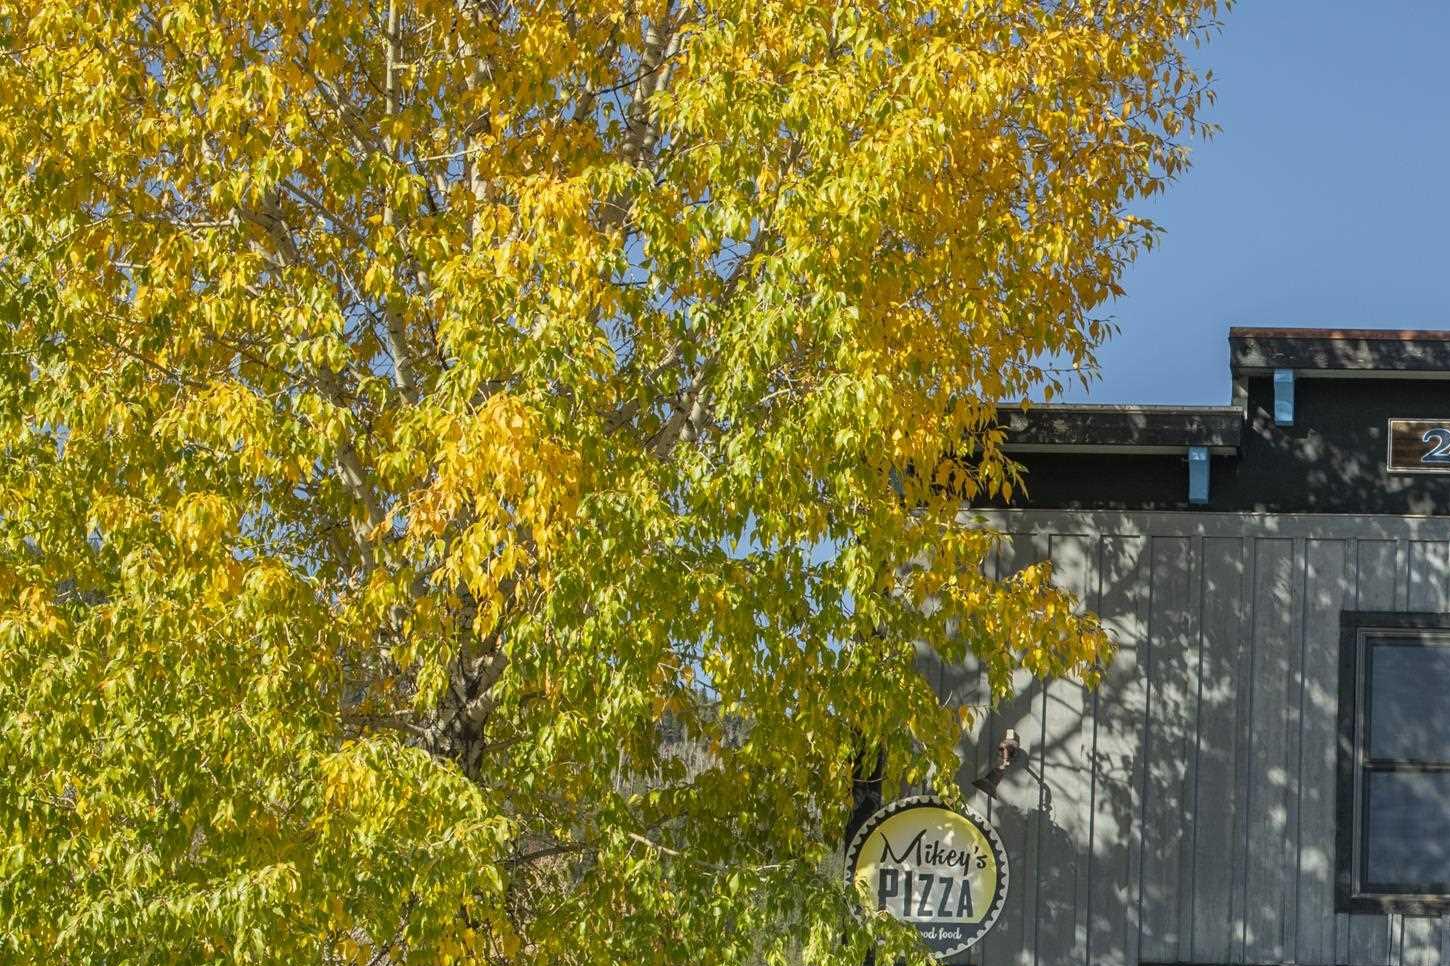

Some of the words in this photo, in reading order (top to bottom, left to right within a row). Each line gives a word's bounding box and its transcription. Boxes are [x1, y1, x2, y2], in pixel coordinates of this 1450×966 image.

[880, 829, 987, 876] Mikey's
[877, 868, 974, 918] PIZZA
[938, 927, 962, 940] food
